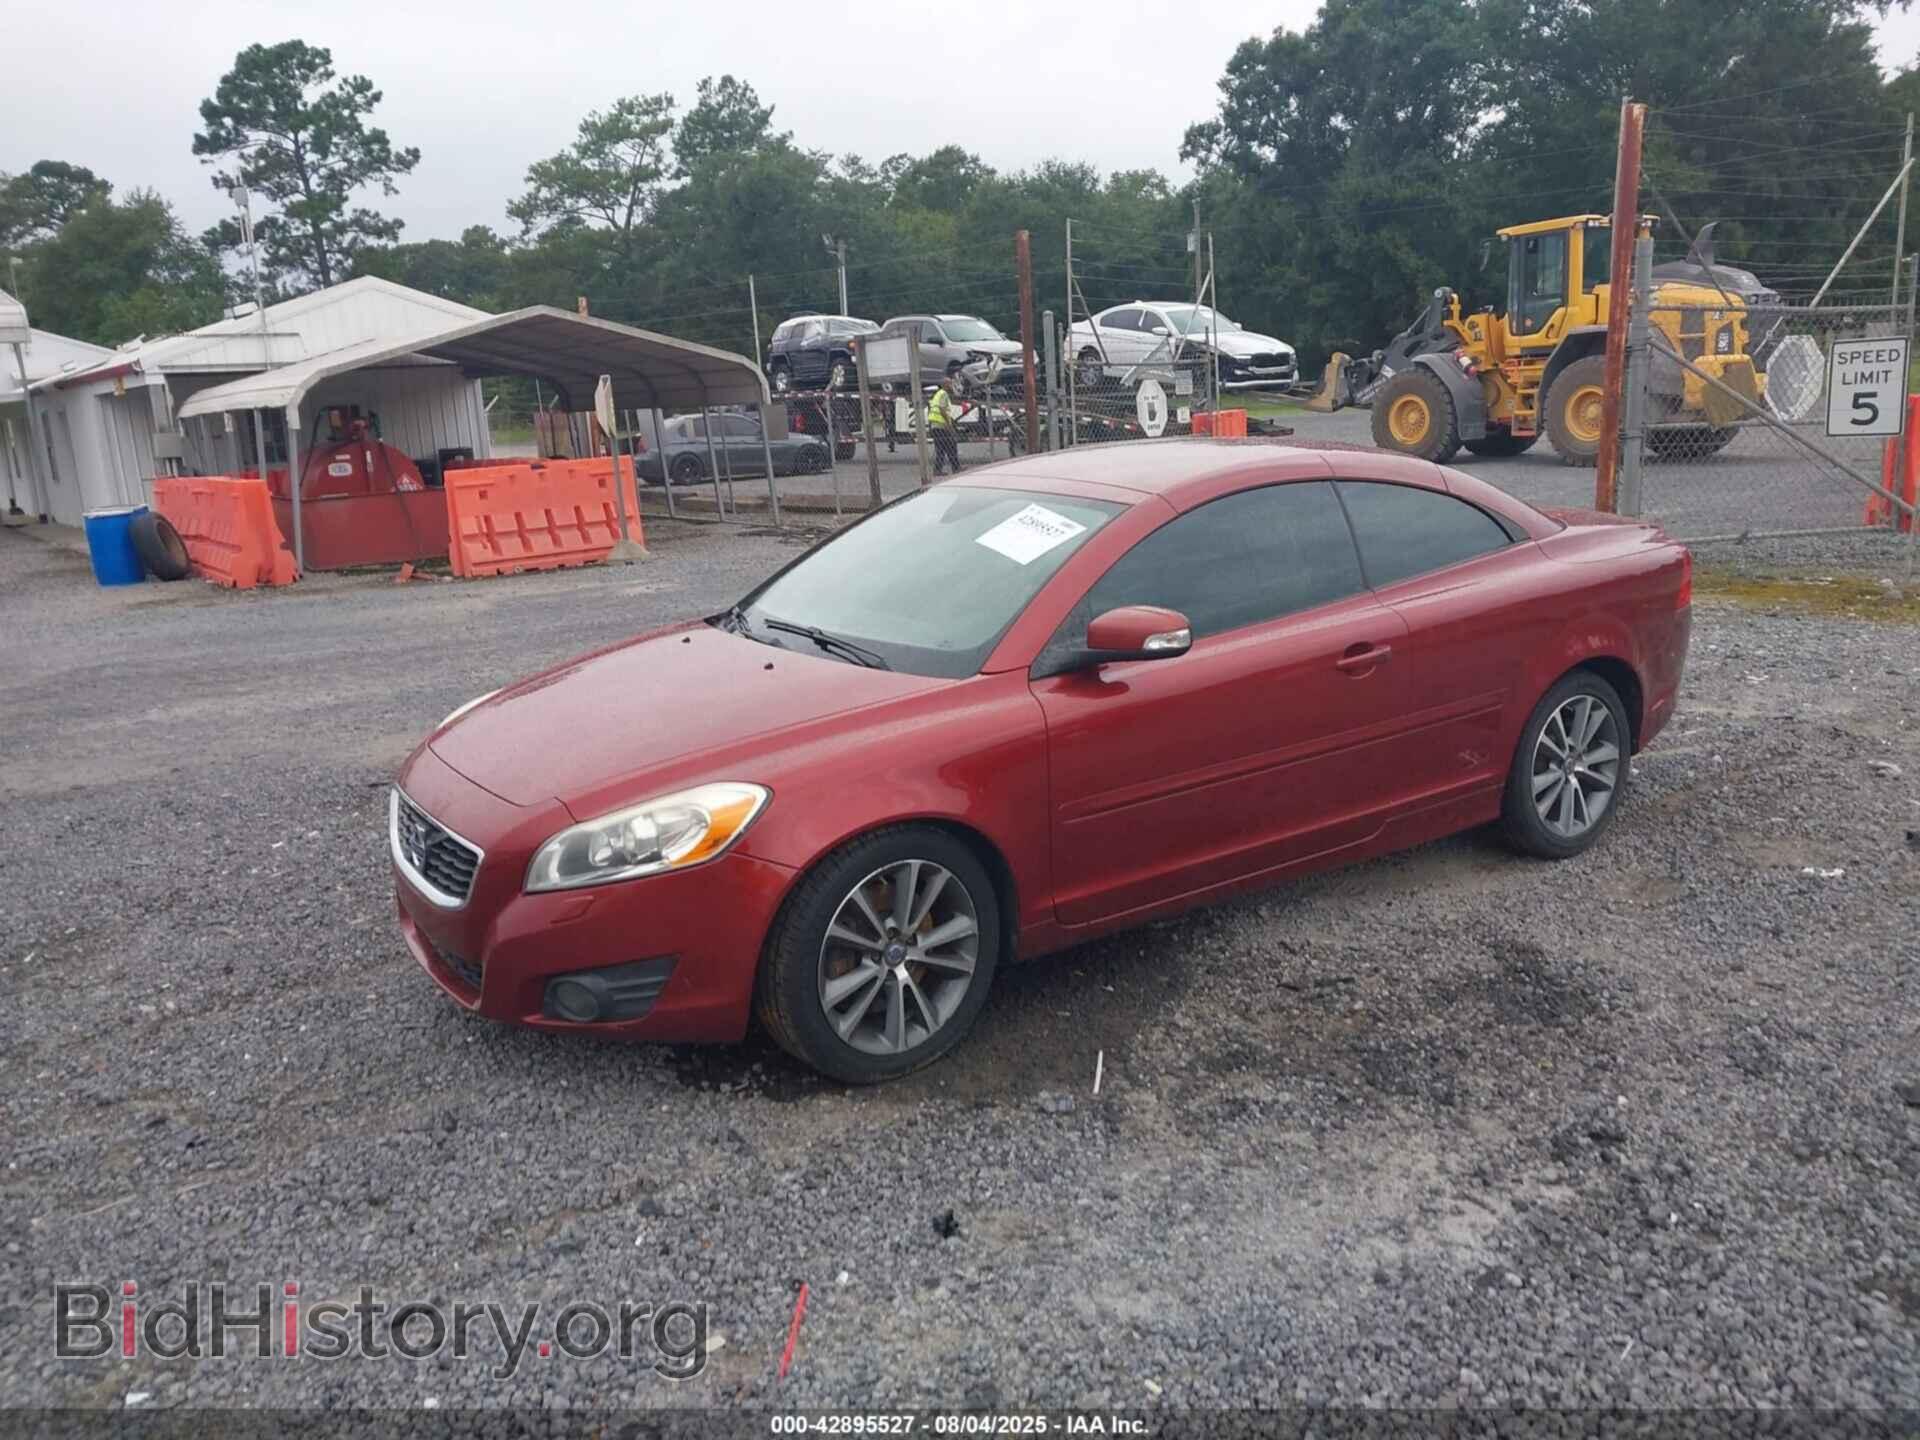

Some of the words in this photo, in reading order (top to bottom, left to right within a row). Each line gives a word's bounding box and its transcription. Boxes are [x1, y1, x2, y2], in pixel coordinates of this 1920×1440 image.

[1837, 349, 1900, 365] SPEED
[1842, 370, 1892, 385] LIMIT
[1850, 391, 1879, 426] 5
